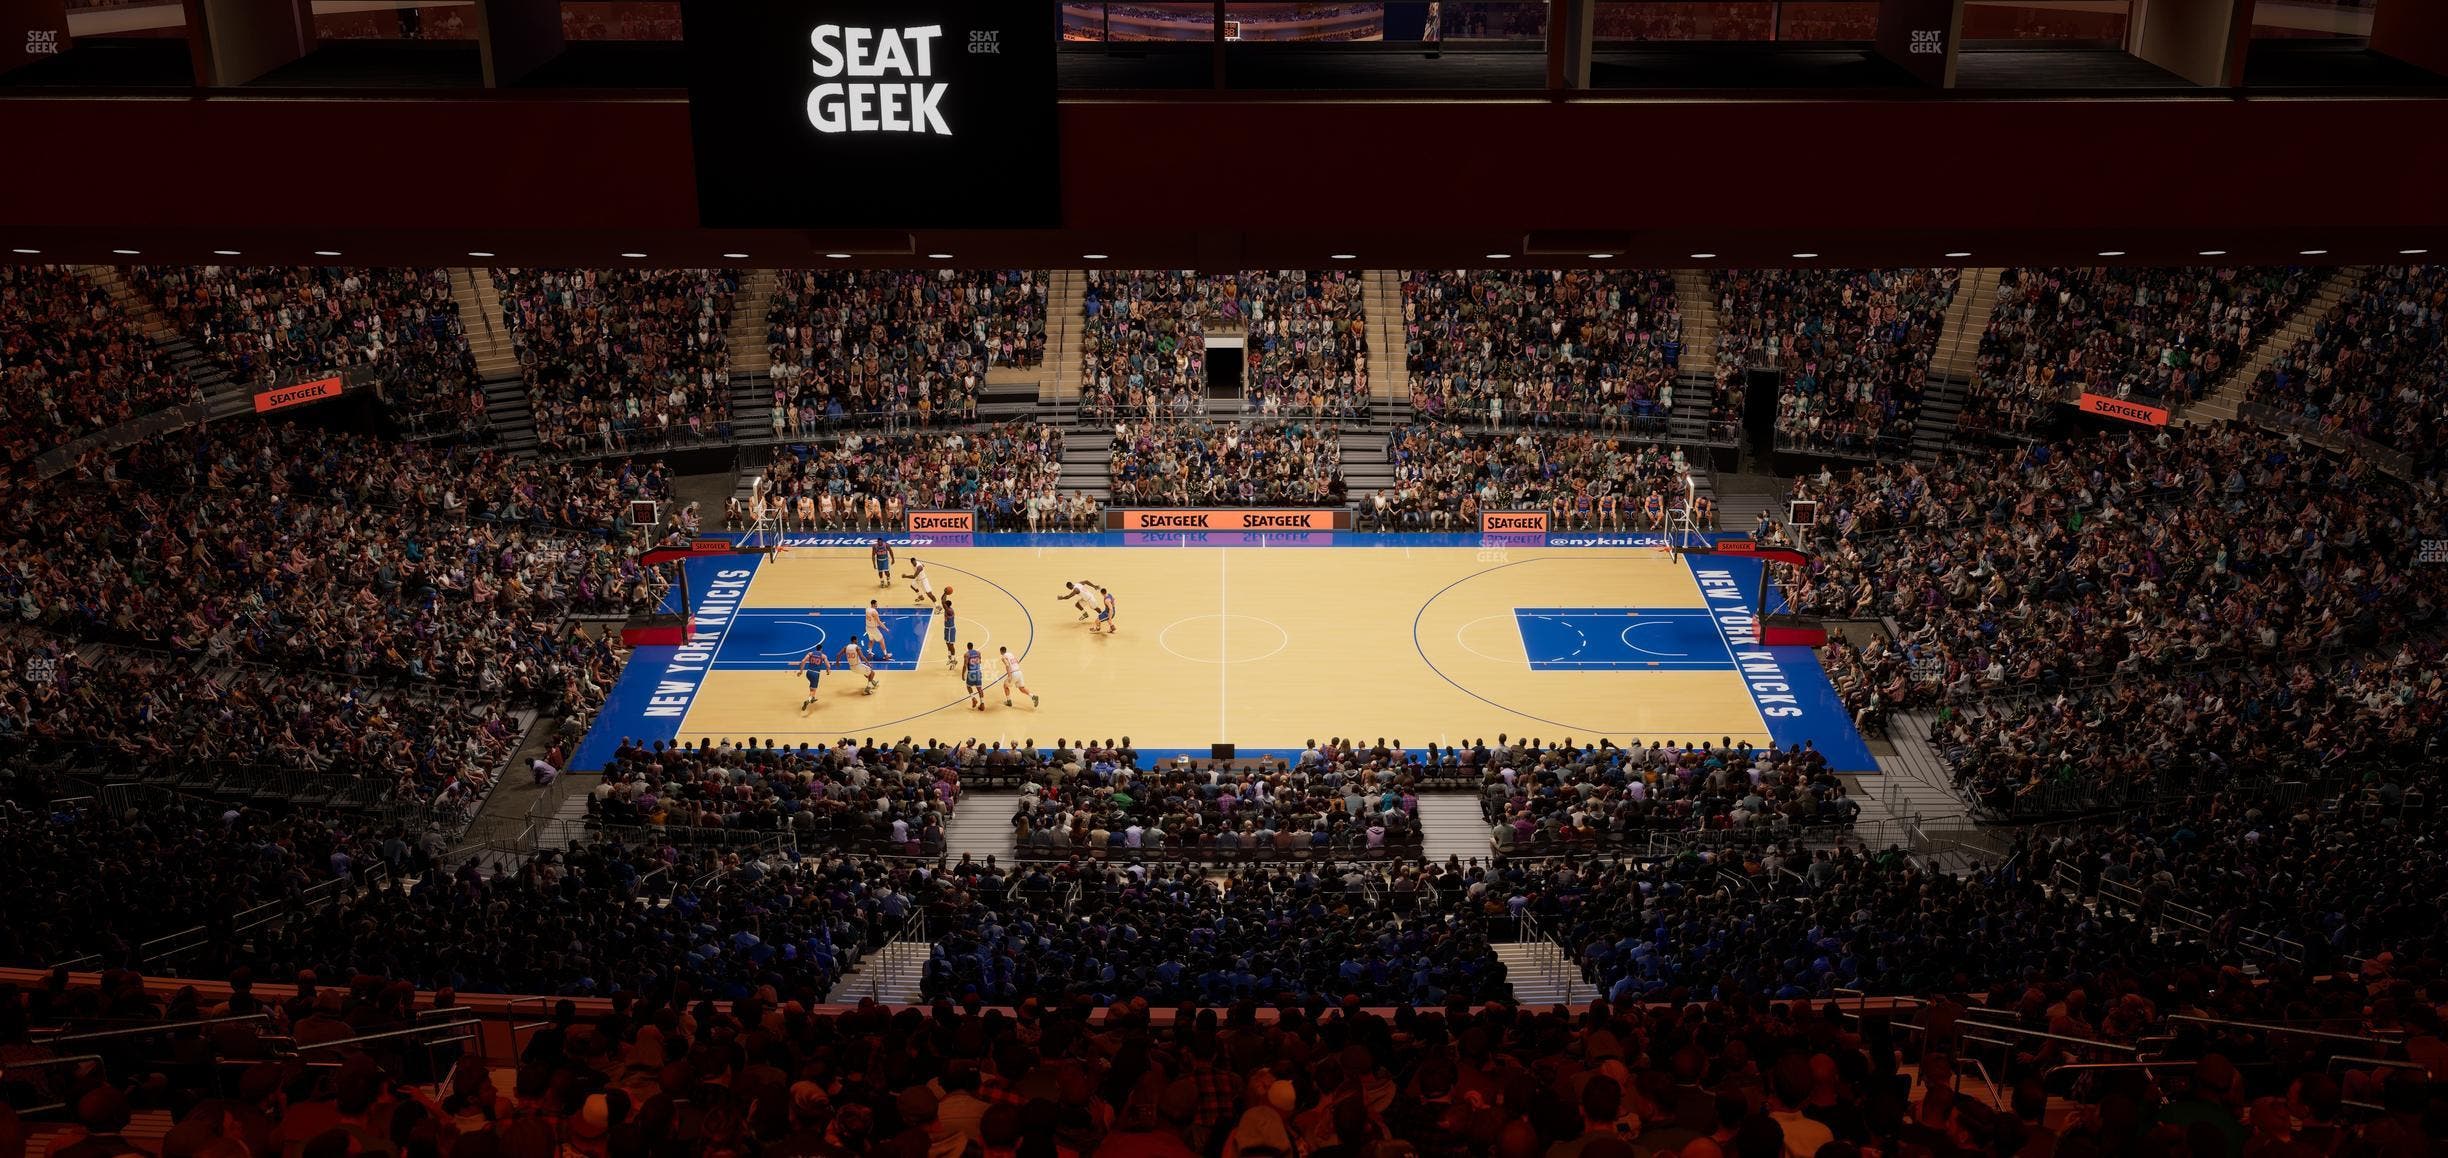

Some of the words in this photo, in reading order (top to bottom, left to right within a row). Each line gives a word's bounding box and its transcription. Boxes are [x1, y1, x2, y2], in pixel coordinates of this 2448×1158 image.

[811, 24, 942, 78] SEAT
[807, 83, 953, 136] GEEK
[269, 384, 327, 406] SEATGEEK
[2095, 400, 2153, 422] SEATGEEK
[913, 516, 969, 530] SEATGEEK
[1141, 514, 1208, 528] SEATGEEK
[1243, 514, 1311, 528] SEATGEEK
[1487, 516, 1543, 530] SEATGEEK
[694, 570, 751, 625] KNICKS
[1696, 570, 1743, 600] NEW
[1714, 605, 1761, 645] YORK
[666, 631, 721, 673] YORK
[643, 680, 696, 716] NEW
[1736, 651, 1803, 717] KNICKS
